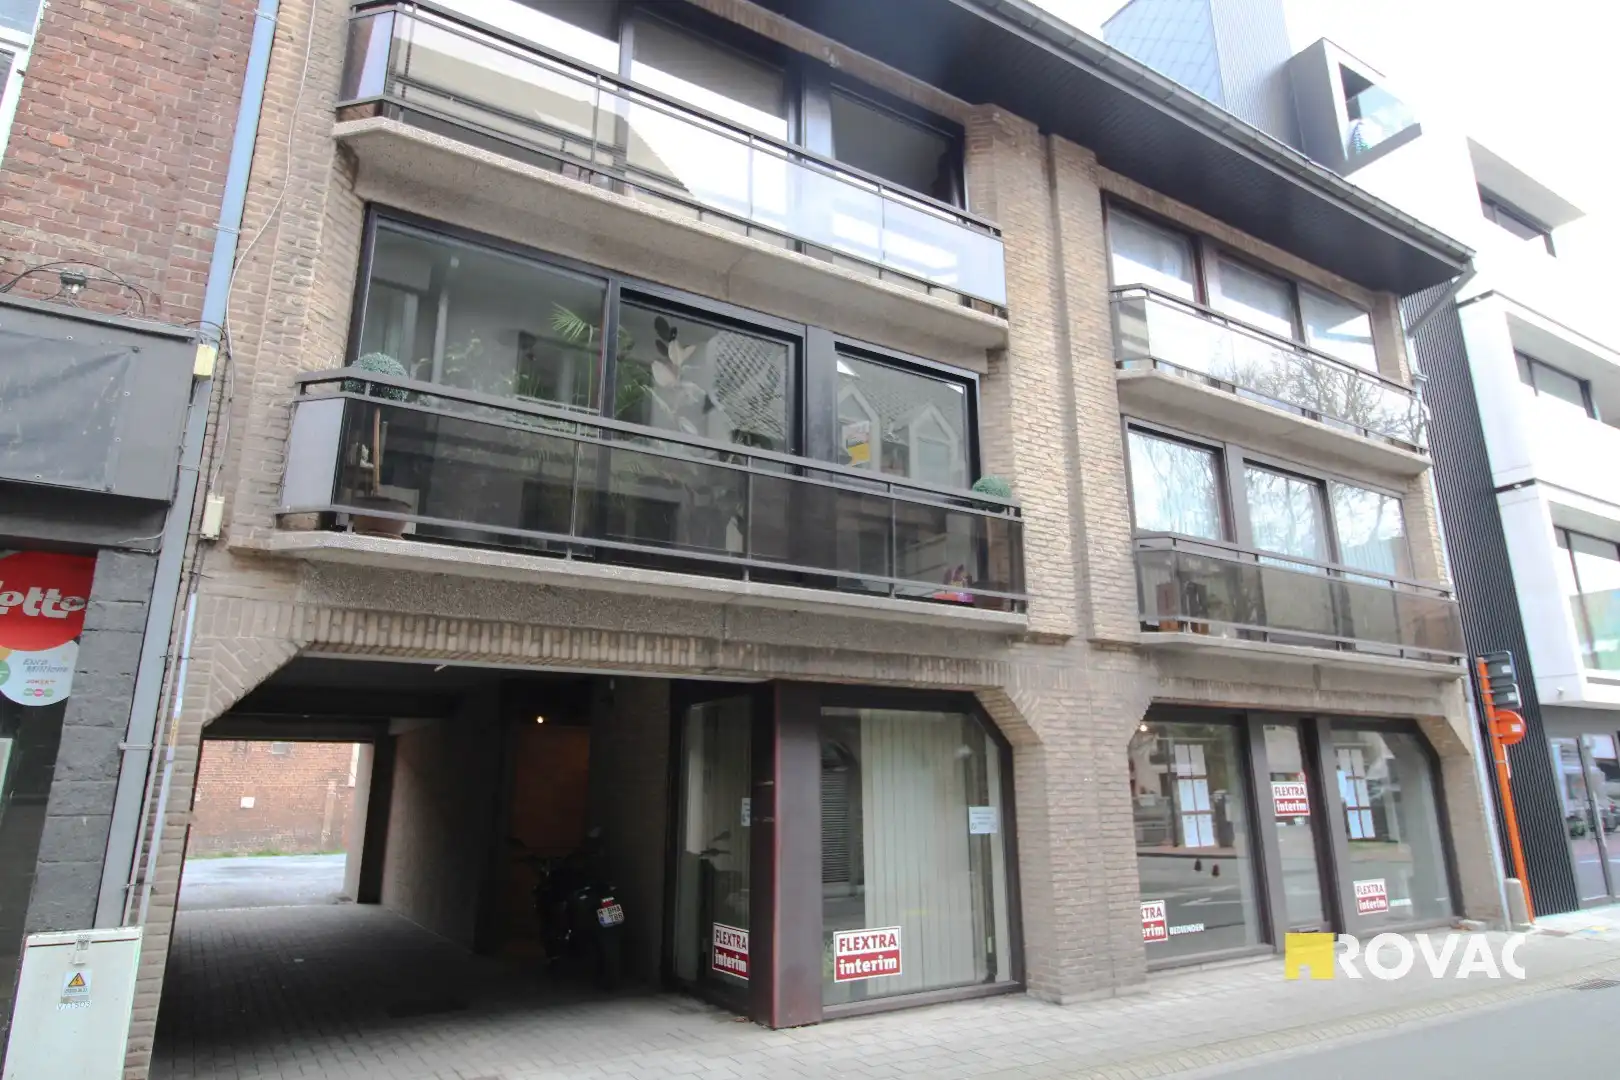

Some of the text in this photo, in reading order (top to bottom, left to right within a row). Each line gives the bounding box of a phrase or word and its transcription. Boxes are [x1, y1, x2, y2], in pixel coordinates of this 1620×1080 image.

[1274, 786, 1305, 797] FLEXTRA
[1276, 799, 1307, 812] interim
[1356, 884, 1384, 896] FLEXTRA
[1359, 897, 1386, 911] interim
[715, 929, 747, 950] FLEXTRA
[839, 933, 897, 952] FLEXTRA
[715, 949, 747, 973] interim
[839, 954, 897, 975] interim
